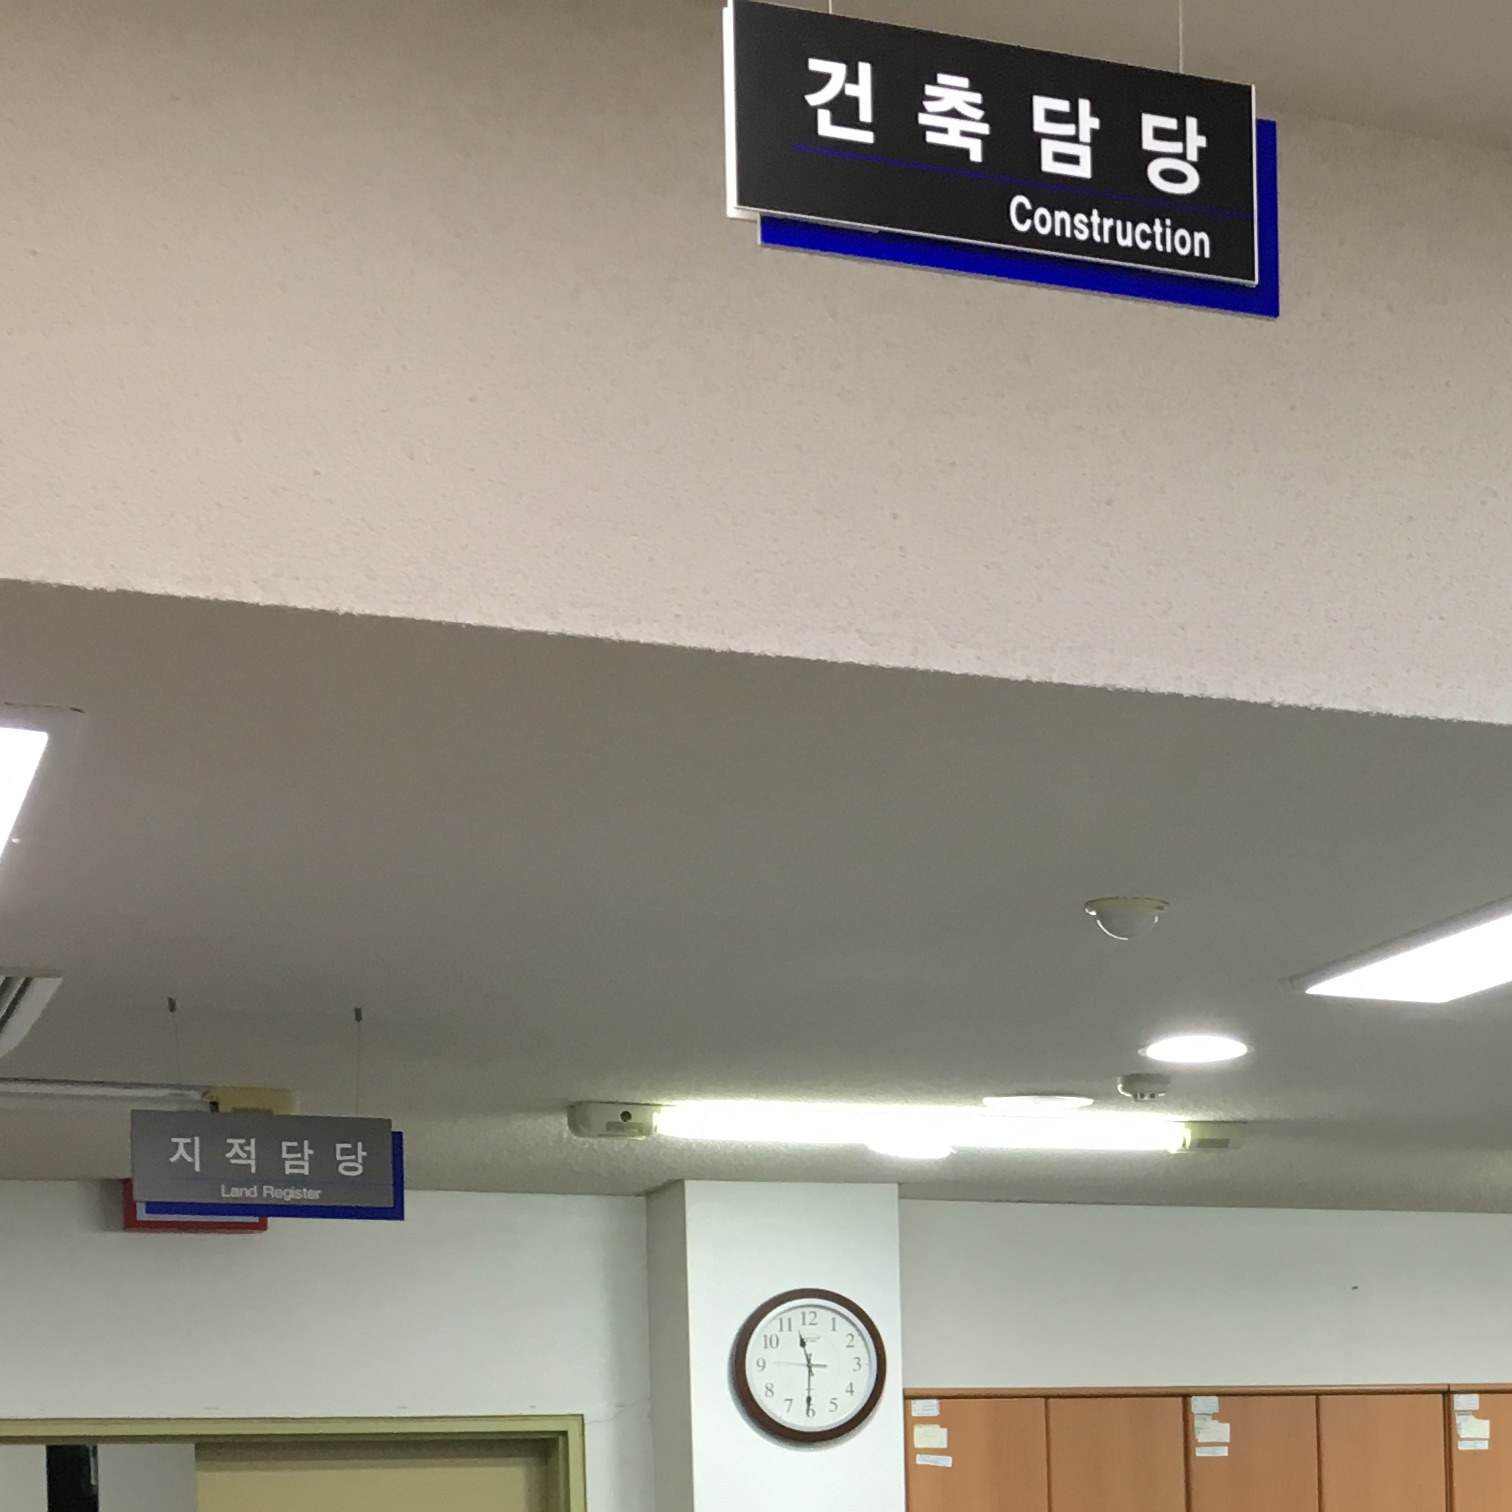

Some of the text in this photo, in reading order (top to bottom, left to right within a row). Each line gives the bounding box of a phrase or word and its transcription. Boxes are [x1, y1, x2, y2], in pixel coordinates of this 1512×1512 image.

[804, 57, 1206, 195] 건축담당
[1009, 195, 1210, 259] Construction
[169, 1135, 367, 1177] 지적담당
[220, 1183, 322, 1201] Land Register
[778, 1317, 793, 1332] 11
[800, 1311, 818, 1326] 12
[831, 1317, 837, 1332] 1
[763, 1334, 779, 1349] 10
[845, 1333, 855, 1348] 2
[756, 1357, 766, 1372] 9
[852, 1357, 862, 1372] 3
[764, 1383, 775, 1398] 8
[845, 1382, 855, 1396] 4
[783, 1399, 793, 1413] 7
[828, 1398, 839, 1413] 5
